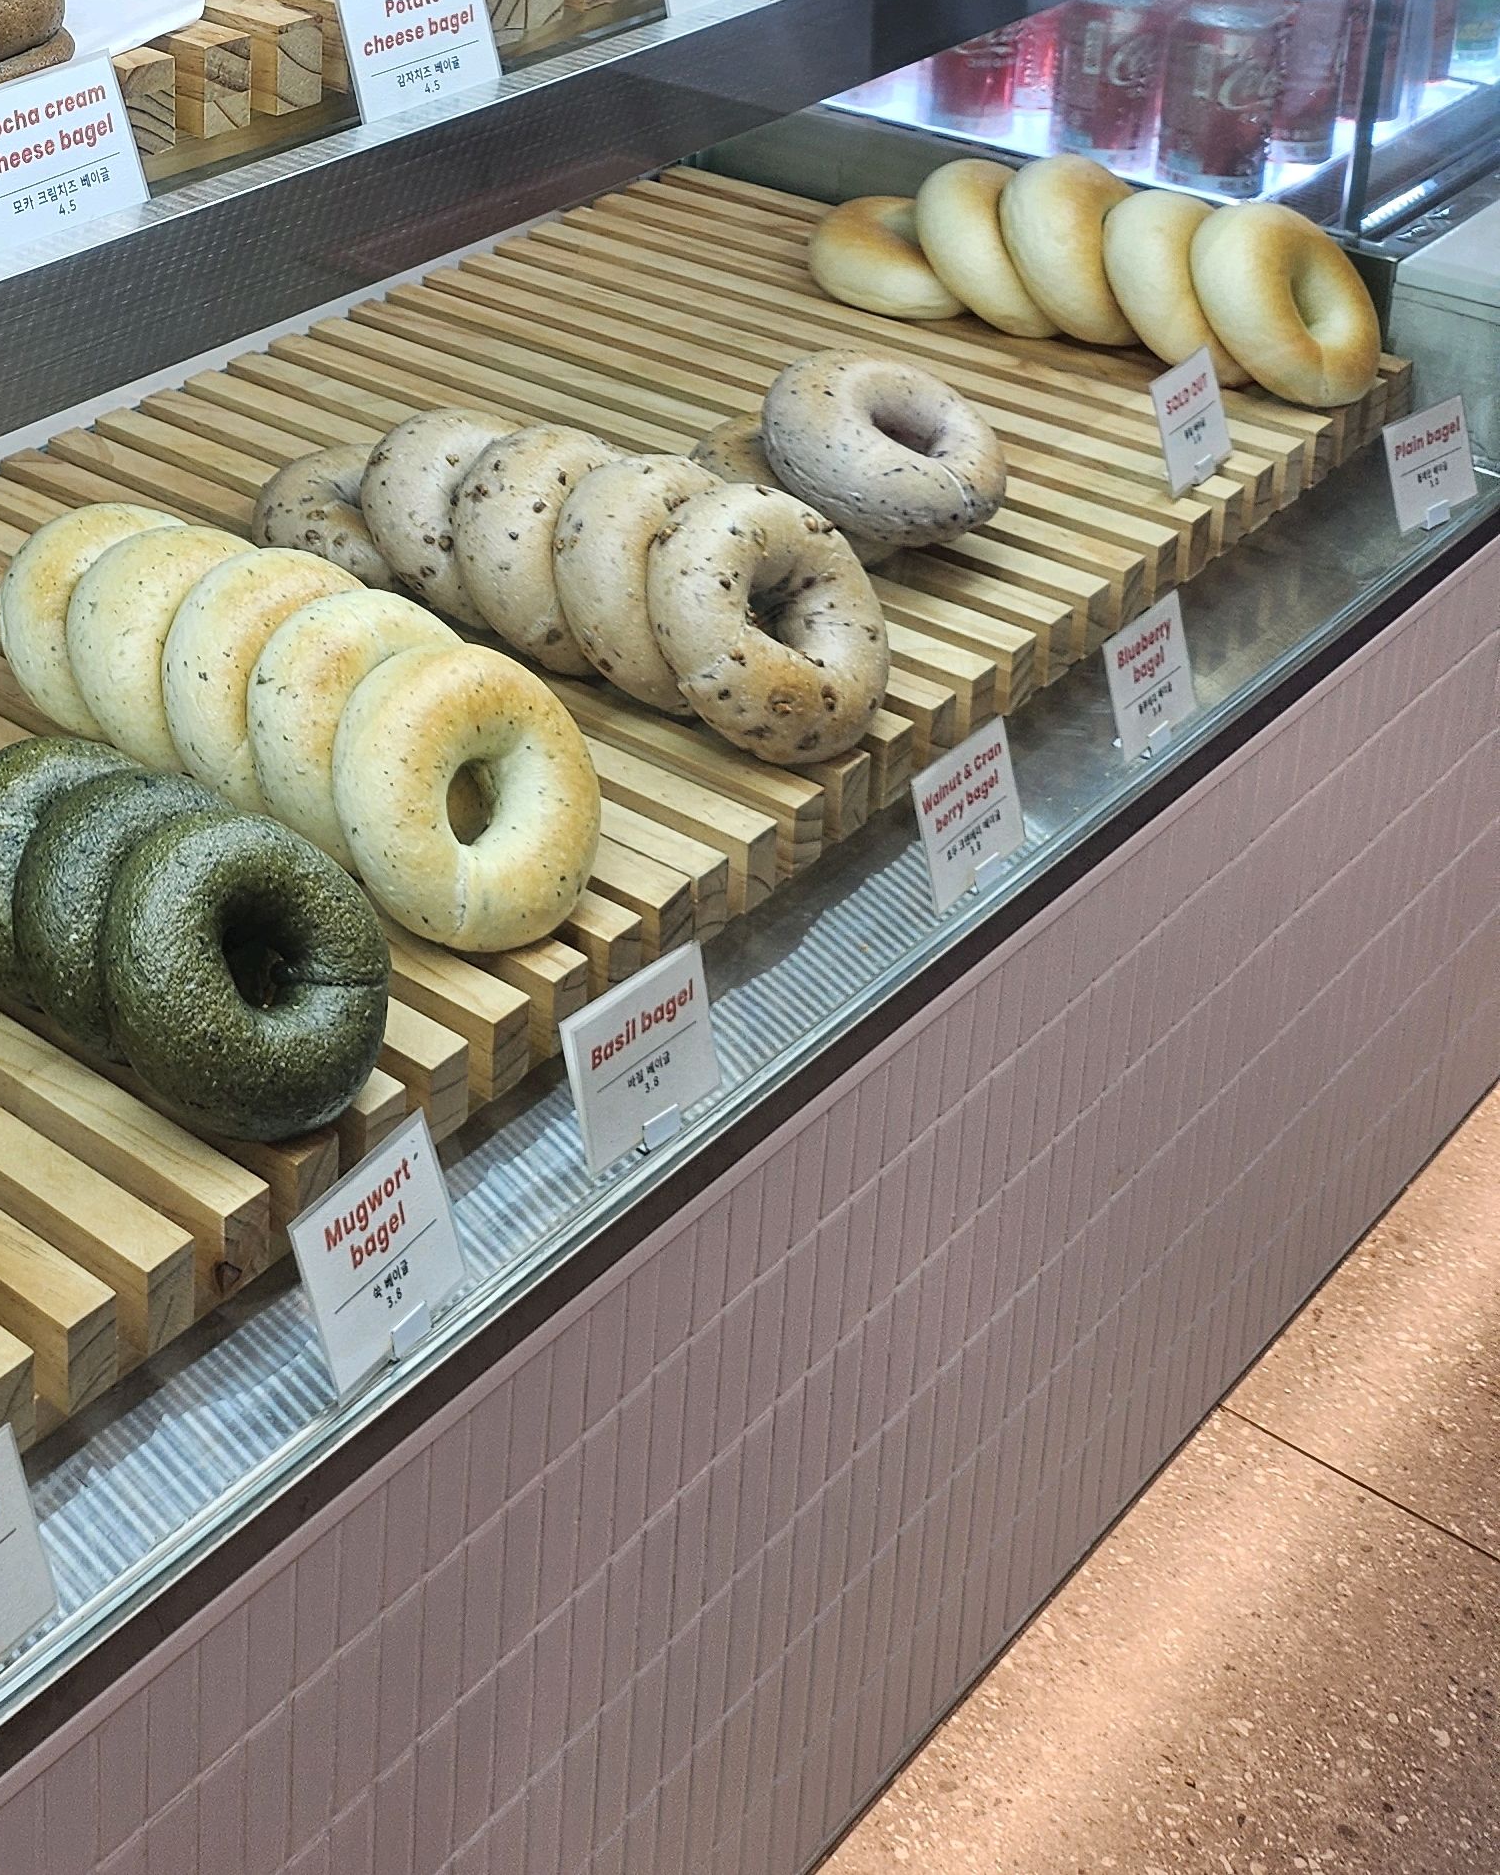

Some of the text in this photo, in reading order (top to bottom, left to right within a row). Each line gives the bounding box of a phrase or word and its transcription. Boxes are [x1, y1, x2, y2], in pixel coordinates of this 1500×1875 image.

[363, 4, 474, 57] cheese bagel
[45, 84, 106, 119] cream
[59, 113, 114, 151] bagel
[13, 166, 111, 215] 모카 크림치즈 베이글
[59, 199, 77, 216] 4.5
[1395, 415, 1460, 461] Plain bagel
[1117, 618, 1171, 669] Blueberry
[1133, 645, 1165, 684] bagel
[922, 742, 1002, 815] Walnut & Cran
[935, 768, 999, 834] berry bagel
[591, 978, 694, 1071] Basil bagel
[324, 1157, 411, 1252] Mugwort
[349, 1200, 406, 1270] bagel
